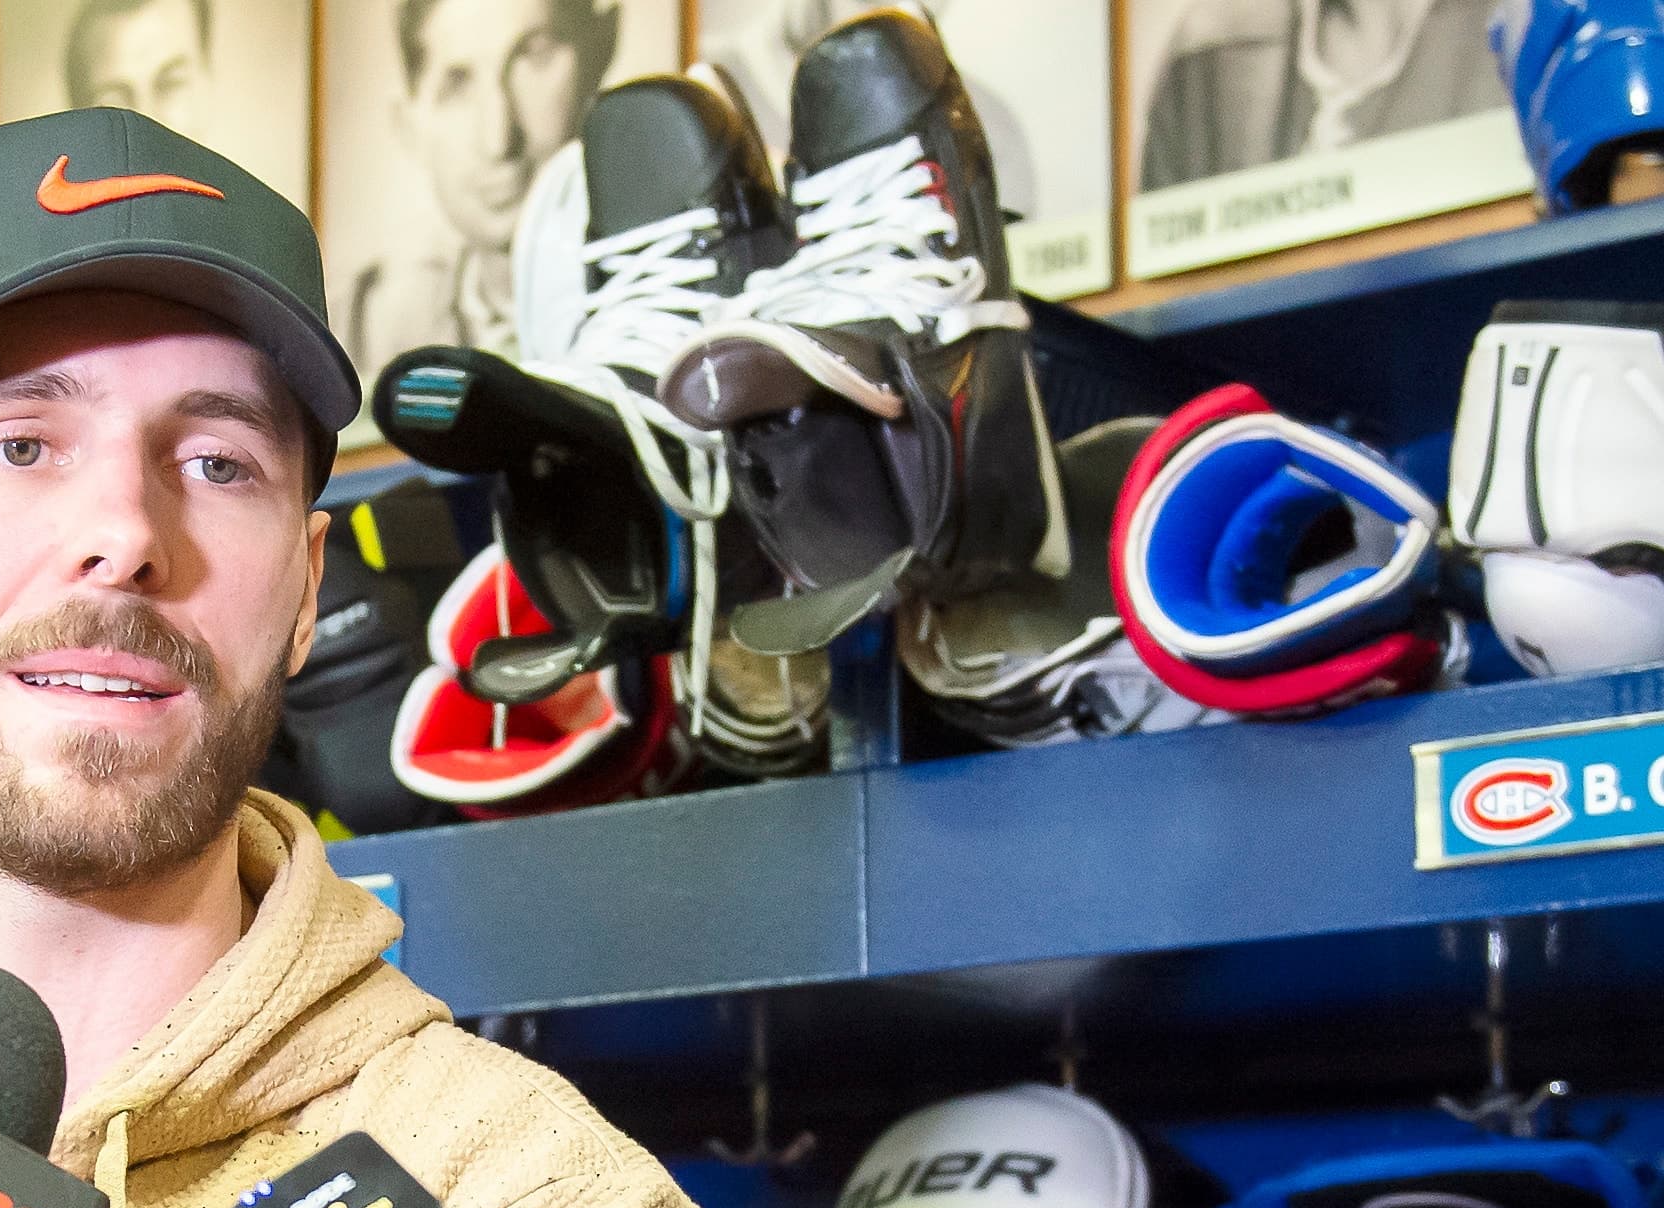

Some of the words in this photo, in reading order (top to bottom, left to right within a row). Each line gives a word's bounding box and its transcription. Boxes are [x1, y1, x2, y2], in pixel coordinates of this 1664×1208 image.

[1145, 208, 1208, 247] TOM
[1216, 170, 1355, 233] JOHNSON
[1583, 763, 1634, 816] B.
